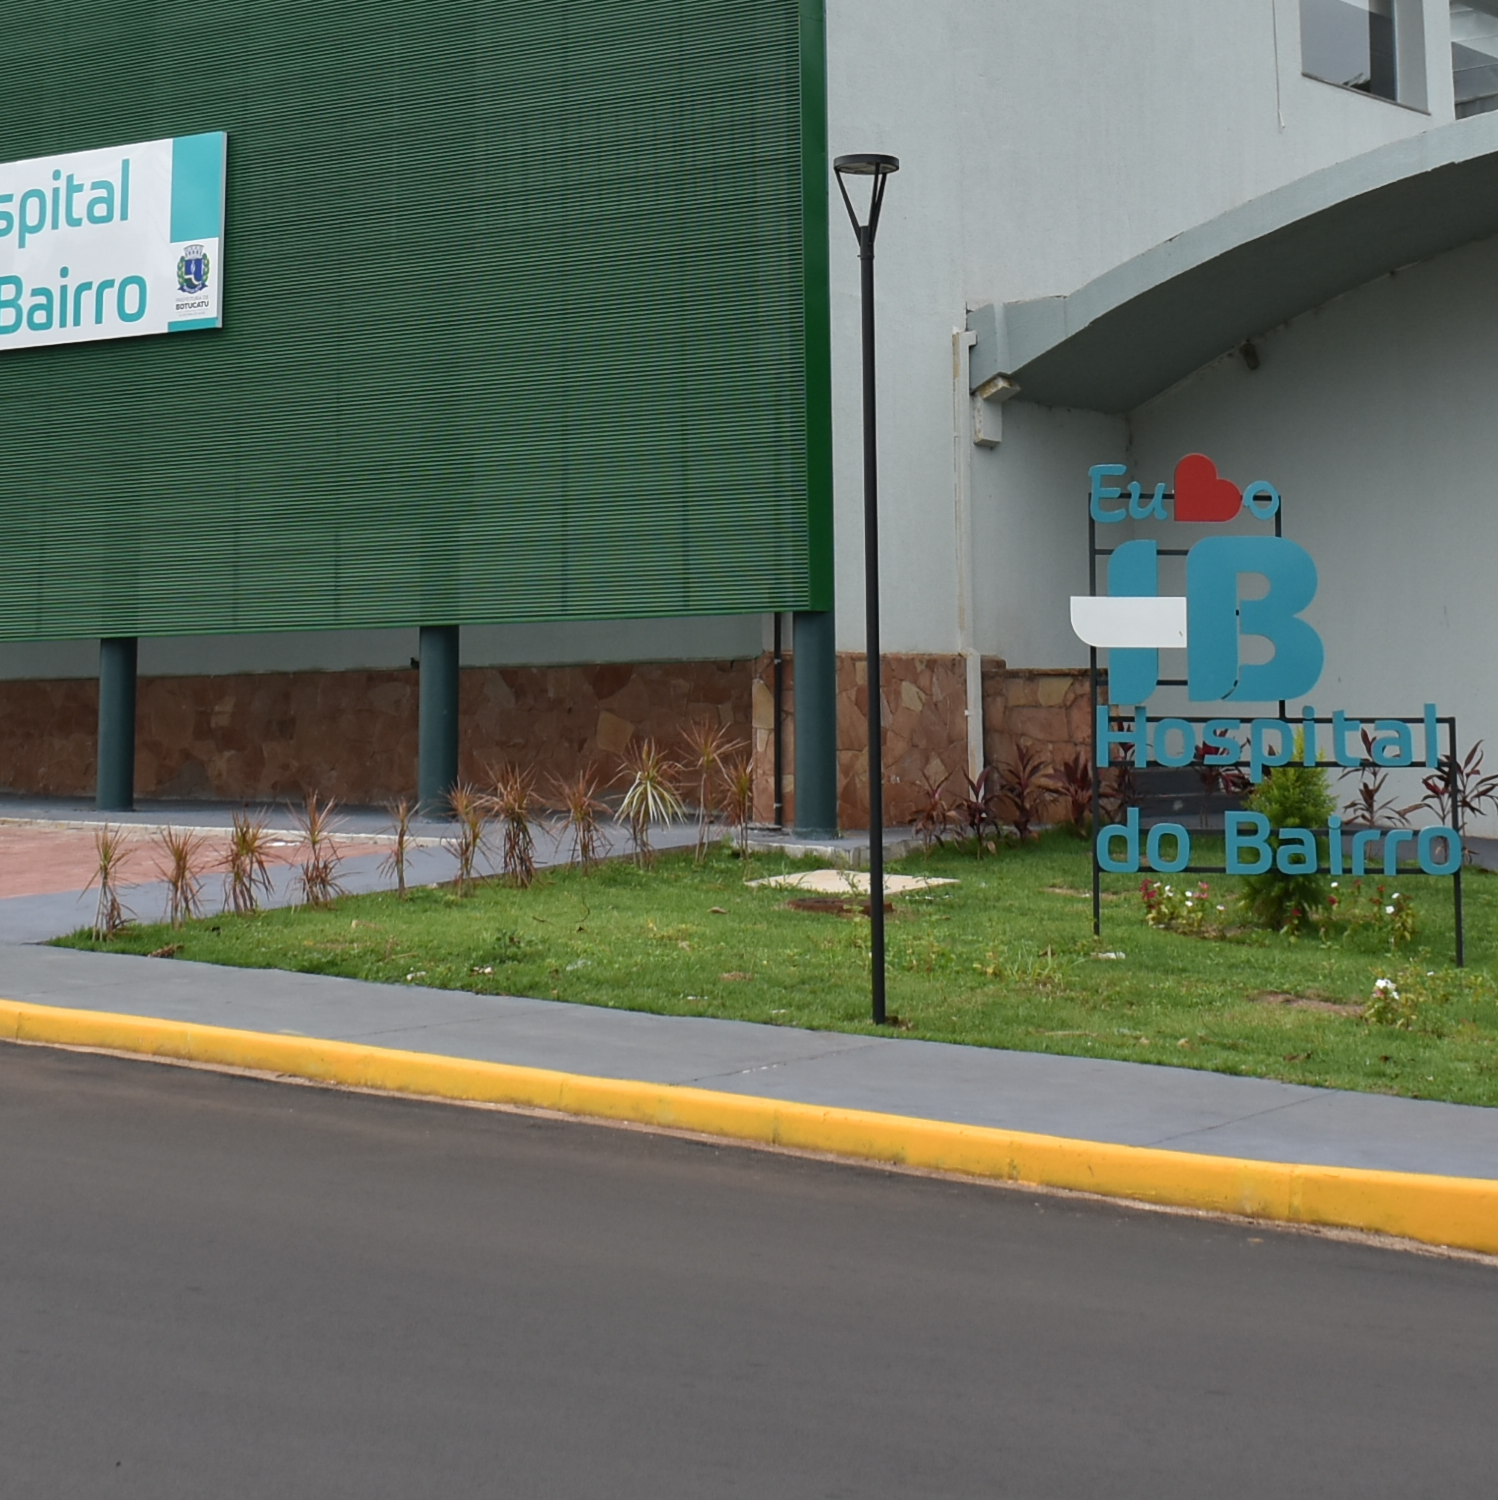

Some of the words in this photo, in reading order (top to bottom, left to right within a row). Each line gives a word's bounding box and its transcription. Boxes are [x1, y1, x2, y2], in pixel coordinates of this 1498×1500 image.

[176, 300, 209, 310] BOTUCATU
[1088, 463, 1170, 524] Eu
[1242, 480, 1281, 521] o
[1095, 703, 1440, 785] Hospital
[1095, 806, 1192, 874] do
[1224, 810, 1464, 877] Bairro
